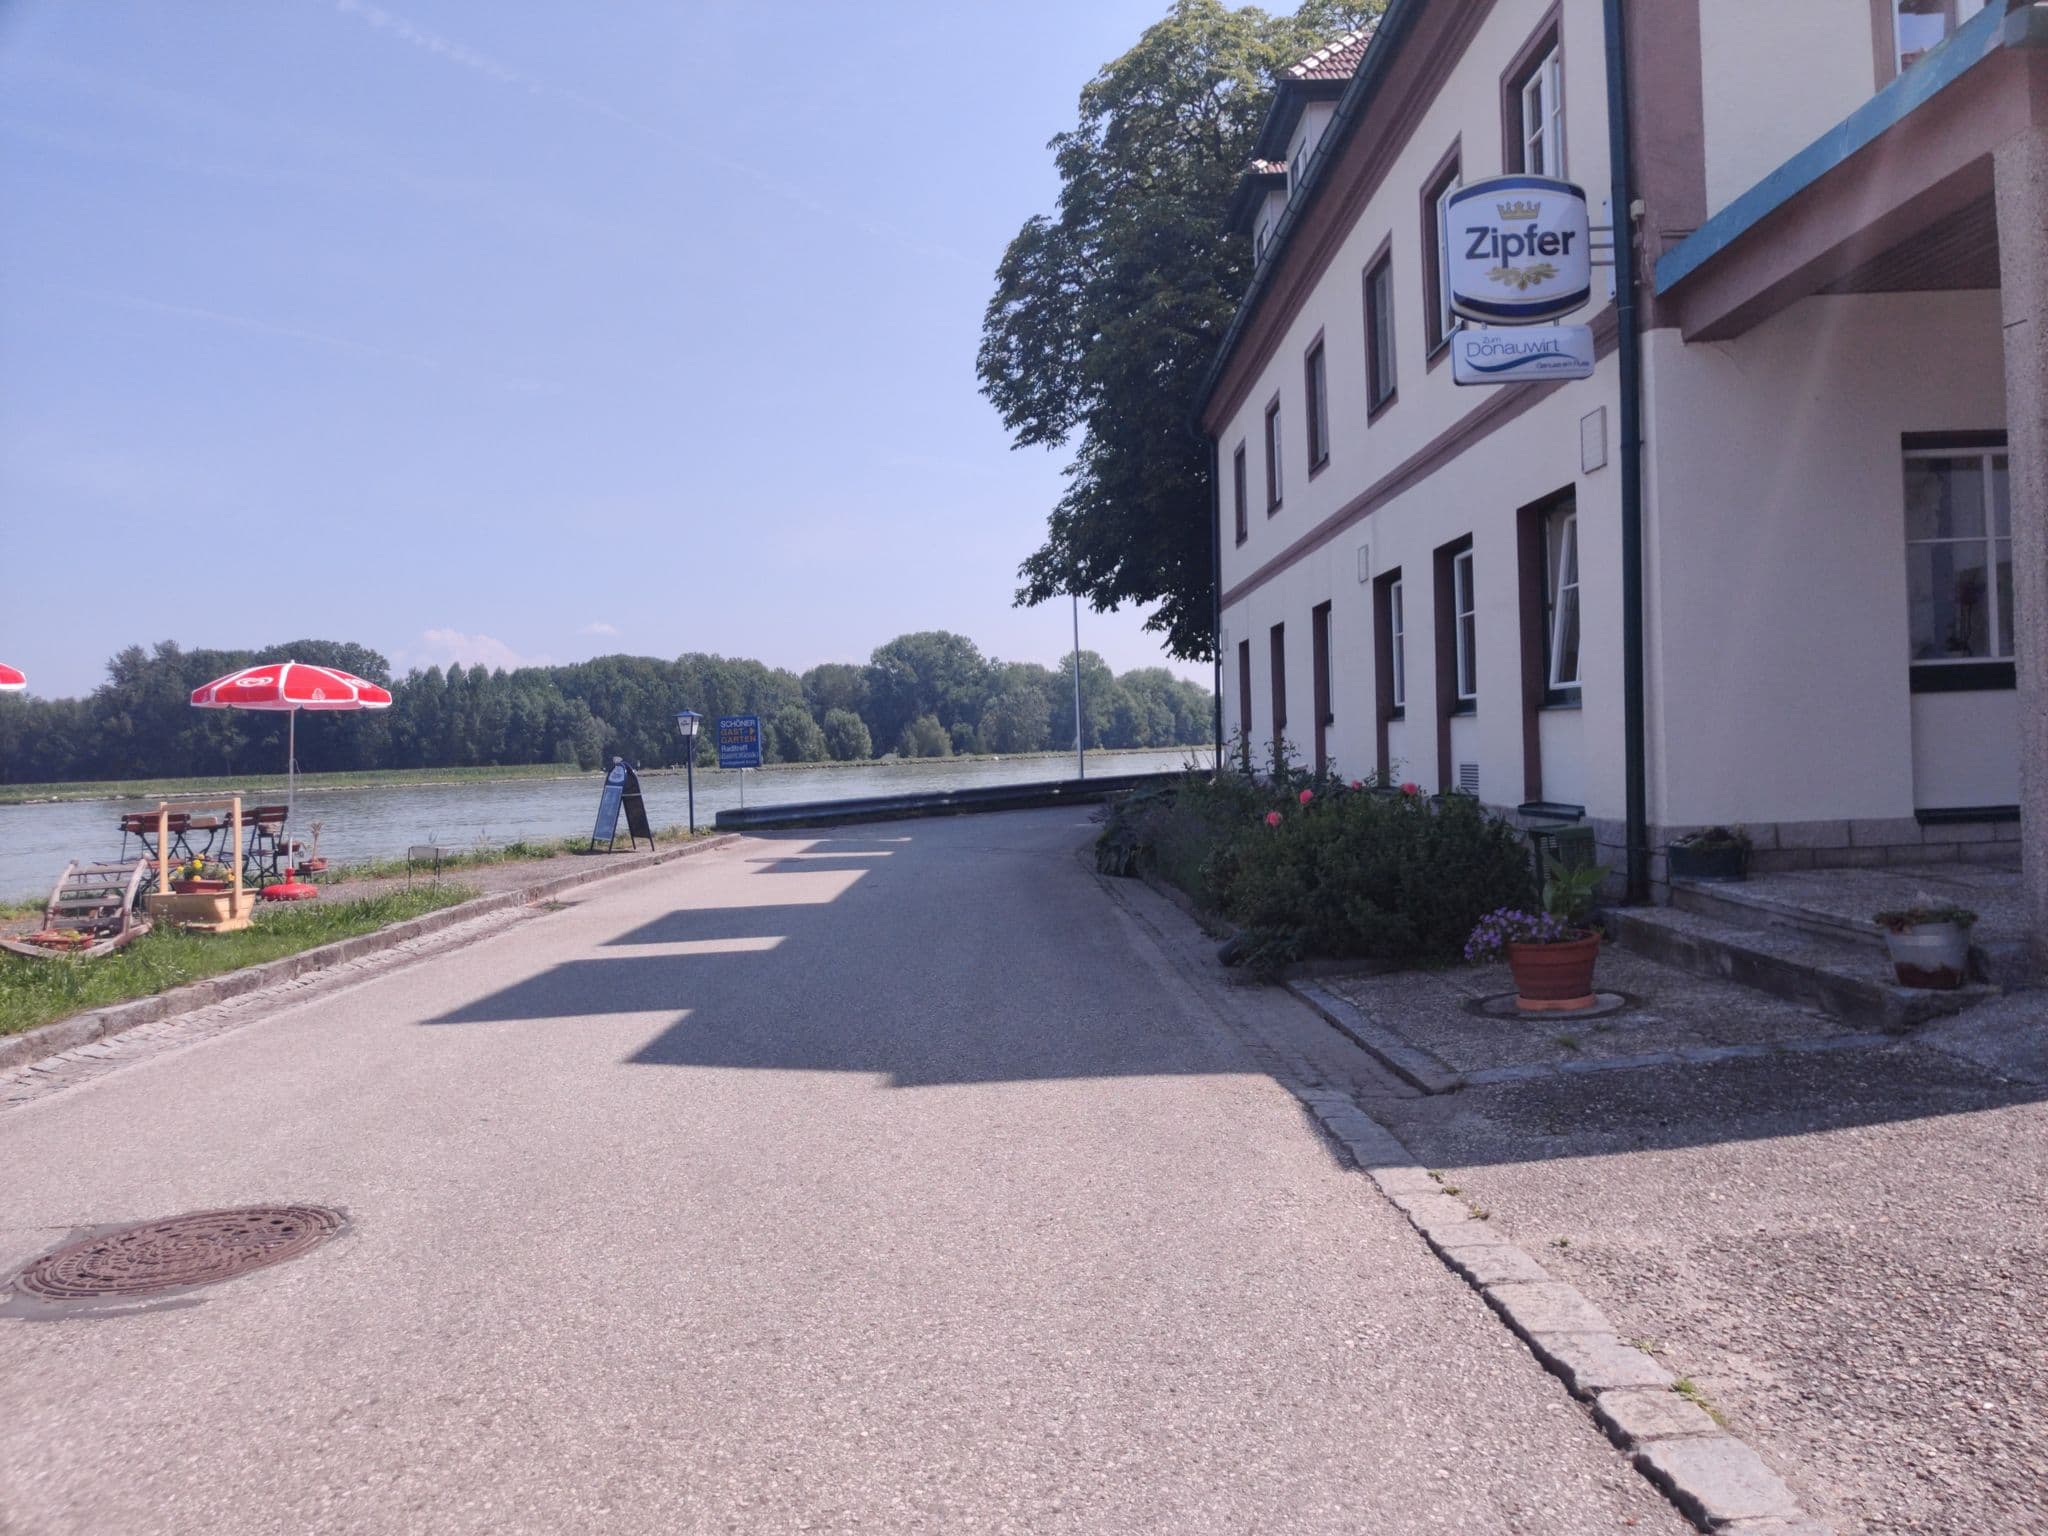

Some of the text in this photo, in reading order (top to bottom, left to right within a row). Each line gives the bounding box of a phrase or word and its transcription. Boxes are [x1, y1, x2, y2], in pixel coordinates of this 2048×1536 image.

[1465, 223, 1576, 269] Zipfer
[1482, 336, 1502, 345] Zum
[1467, 338, 1560, 359] Donauwirt
[720, 719, 756, 728] SCHÖNER
[720, 735, 757, 744] GARTEN
